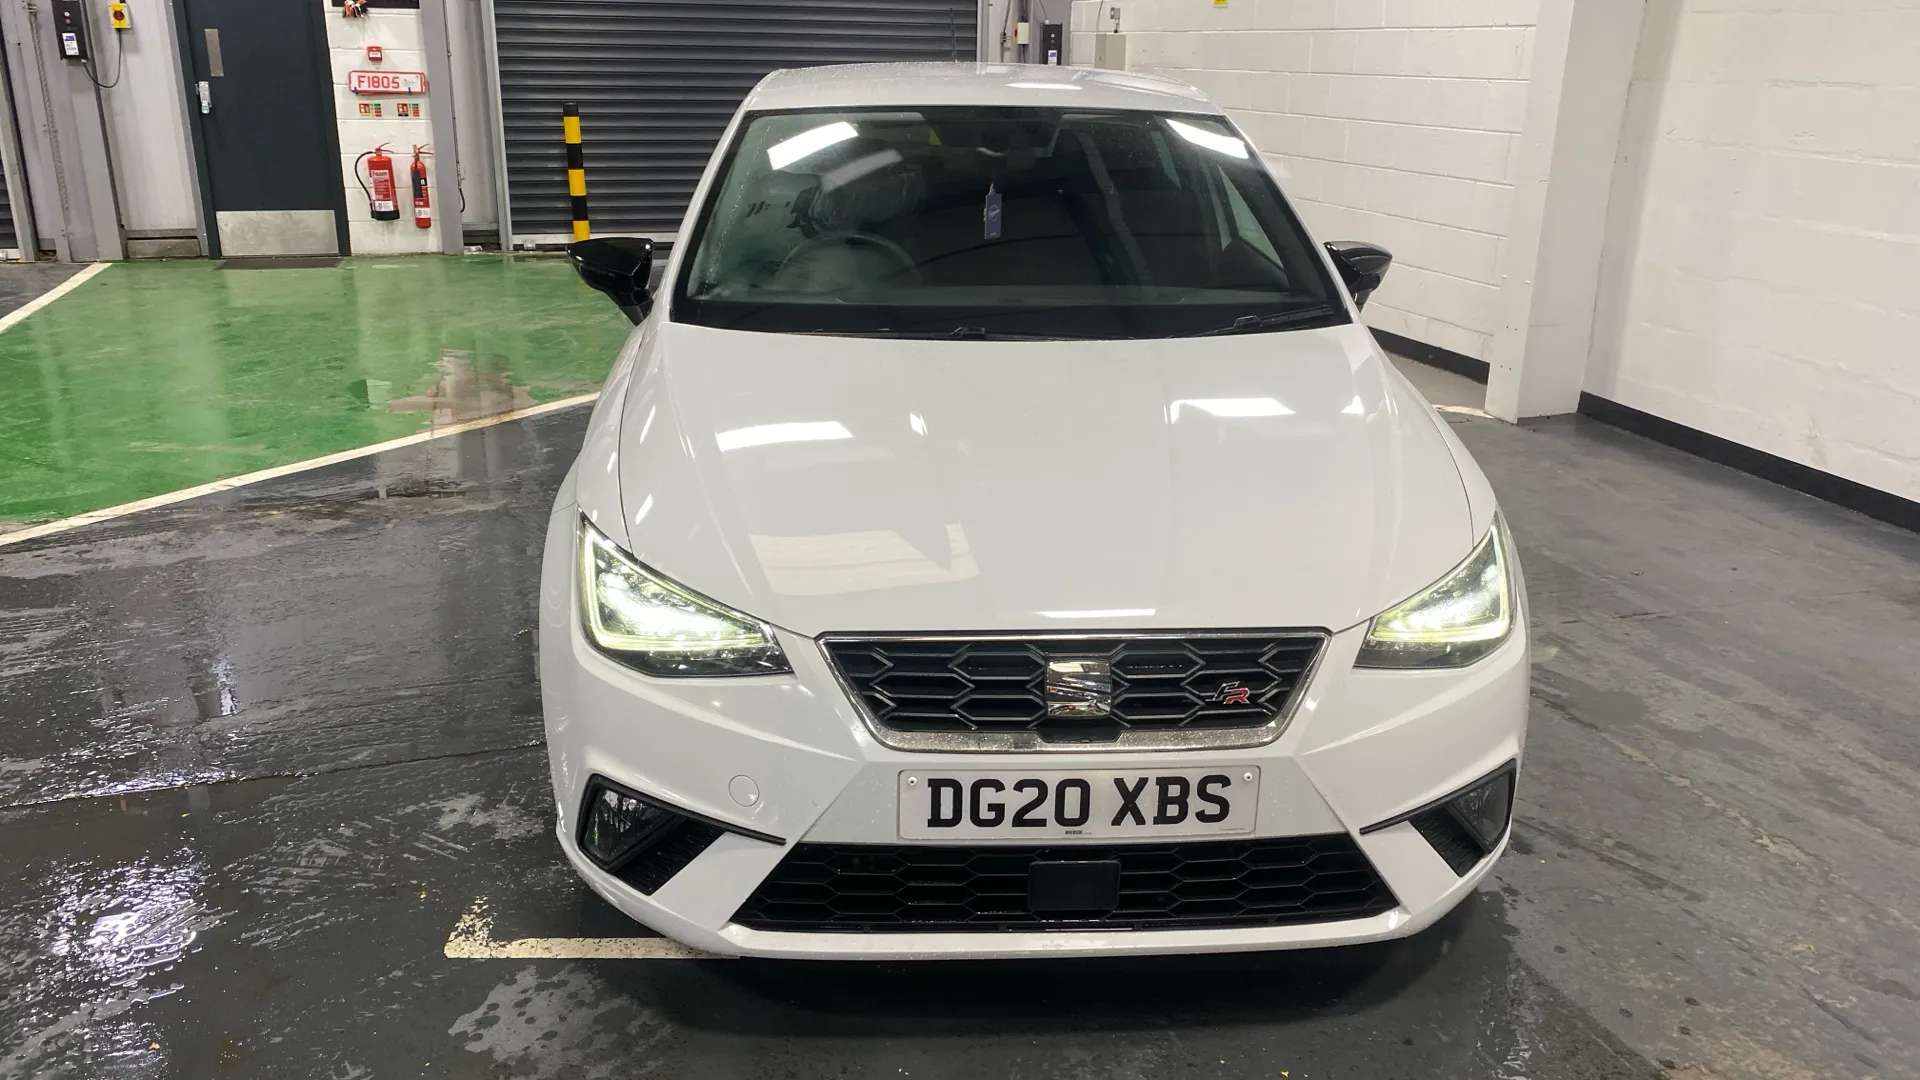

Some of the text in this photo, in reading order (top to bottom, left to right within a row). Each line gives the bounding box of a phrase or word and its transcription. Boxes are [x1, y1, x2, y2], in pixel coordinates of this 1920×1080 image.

[1213, 681, 1250, 704] FR
[927, 774, 1232, 828] DG20 XBS
